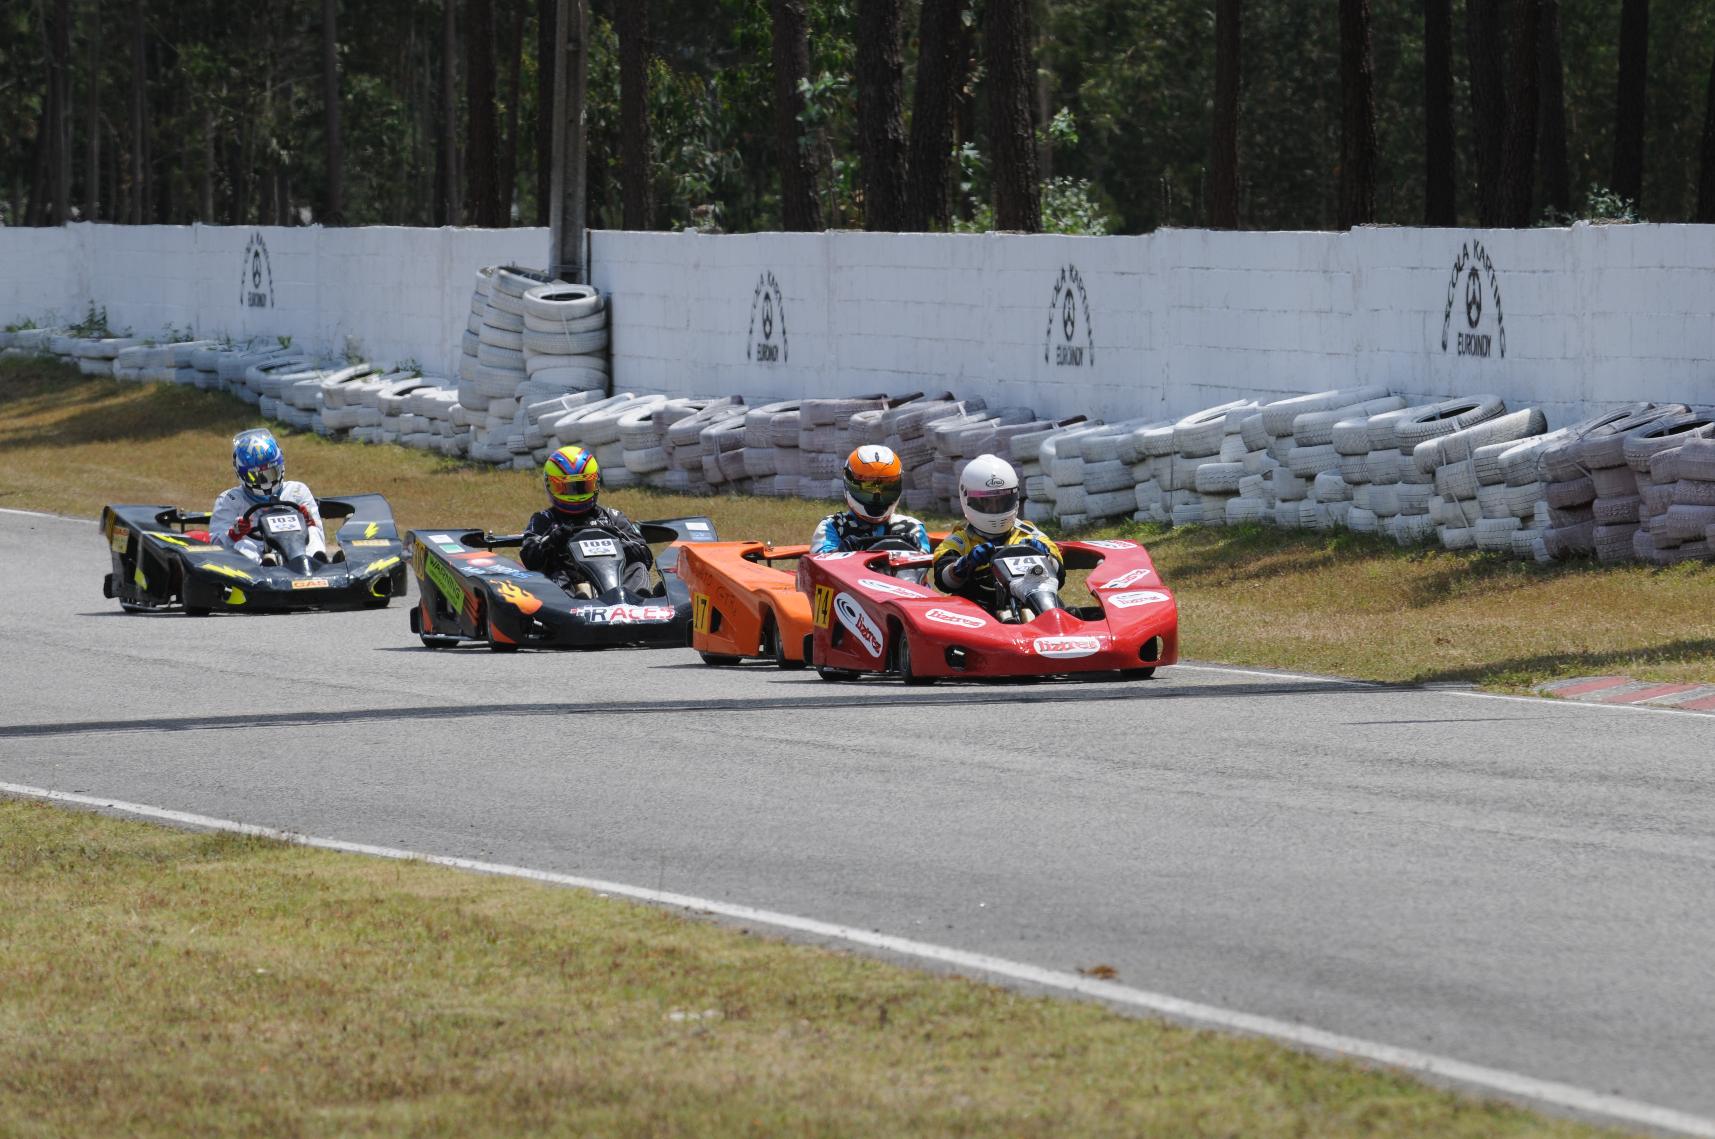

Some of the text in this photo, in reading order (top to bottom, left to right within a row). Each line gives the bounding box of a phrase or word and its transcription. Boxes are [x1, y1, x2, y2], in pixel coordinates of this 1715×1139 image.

[1457, 332, 1492, 358] EUROINDY
[270, 516, 297, 524] 103
[582, 540, 613, 548] 109
[1008, 557, 1037, 566] 74
[694, 595, 708, 630] 17
[816, 588, 830, 625] 74
